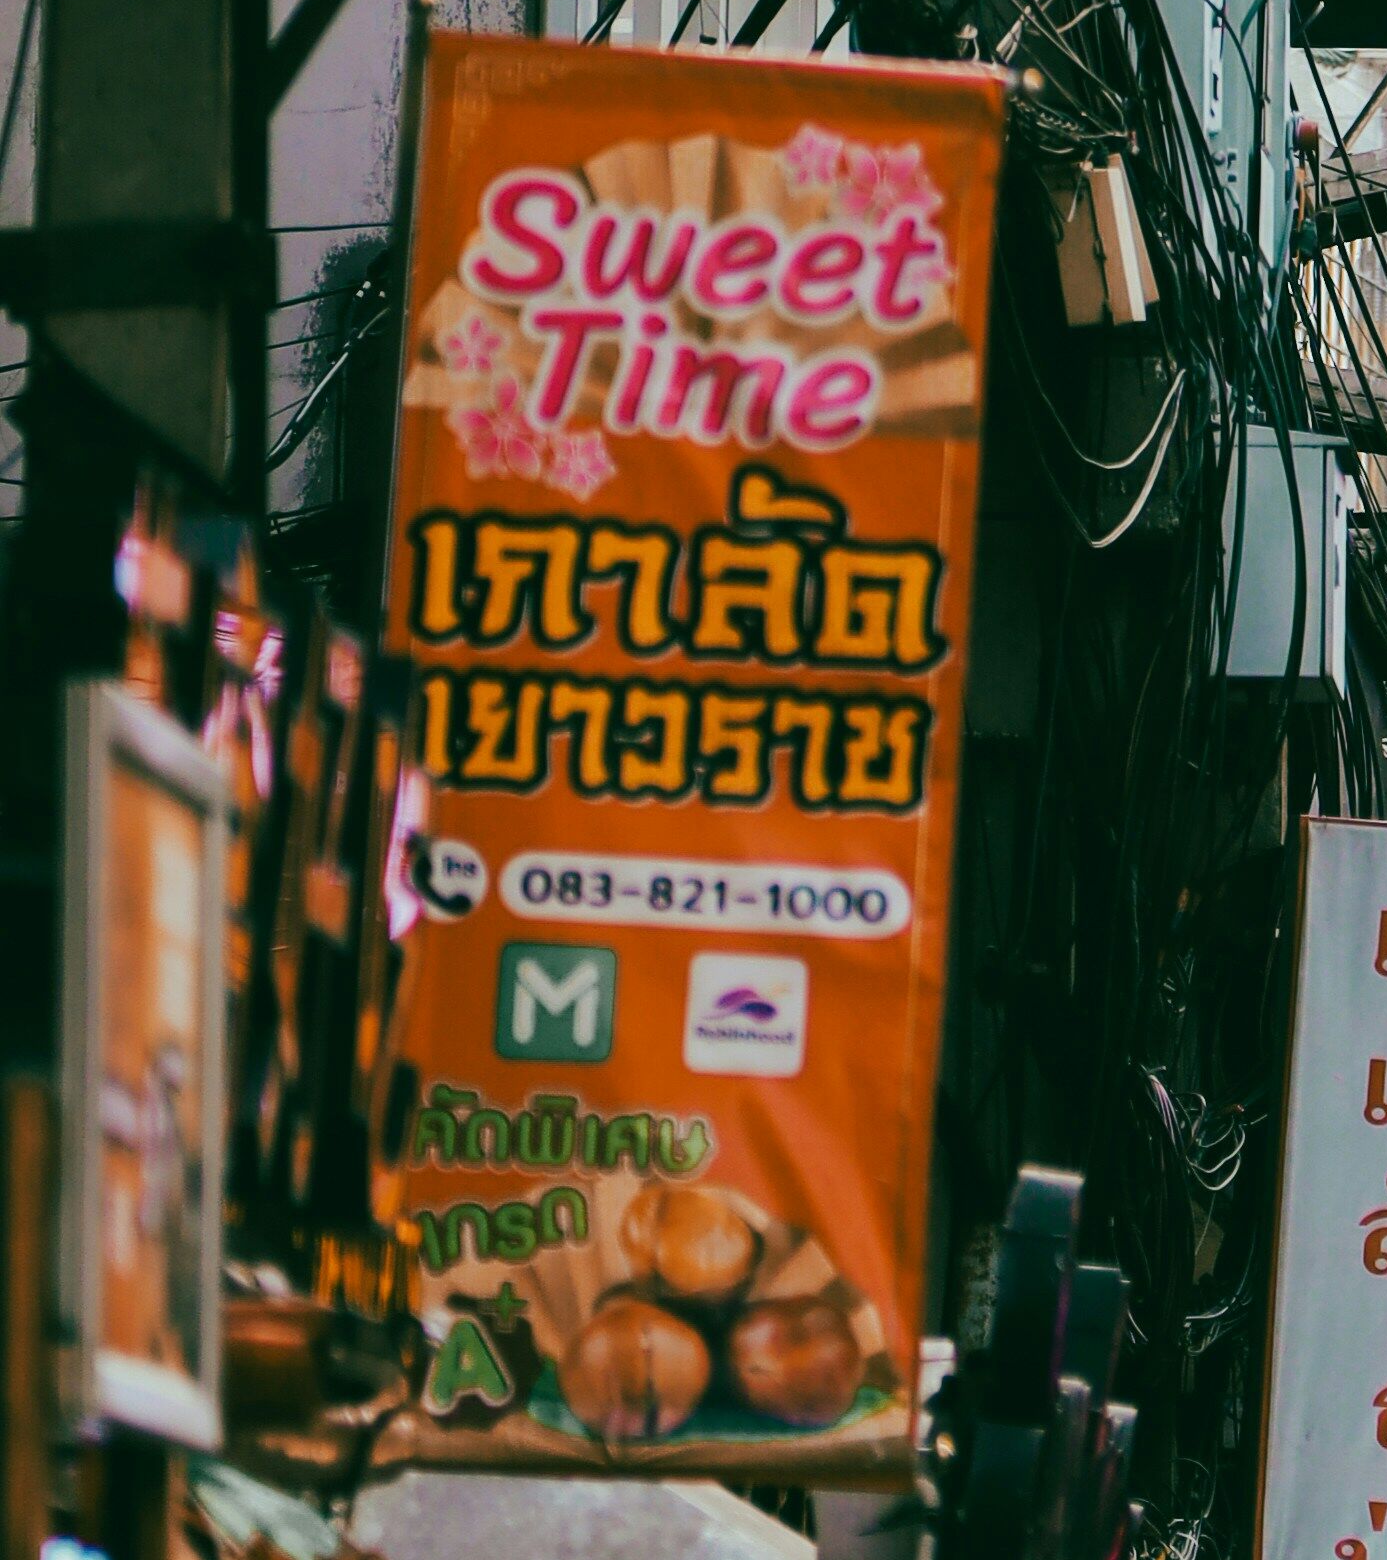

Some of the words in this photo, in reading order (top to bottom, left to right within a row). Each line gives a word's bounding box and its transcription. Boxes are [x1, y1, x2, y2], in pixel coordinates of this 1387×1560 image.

[466, 172, 940, 326] Sweet
[530, 308, 878, 446] Time
[519, 866, 890, 924] 083-821-1000
